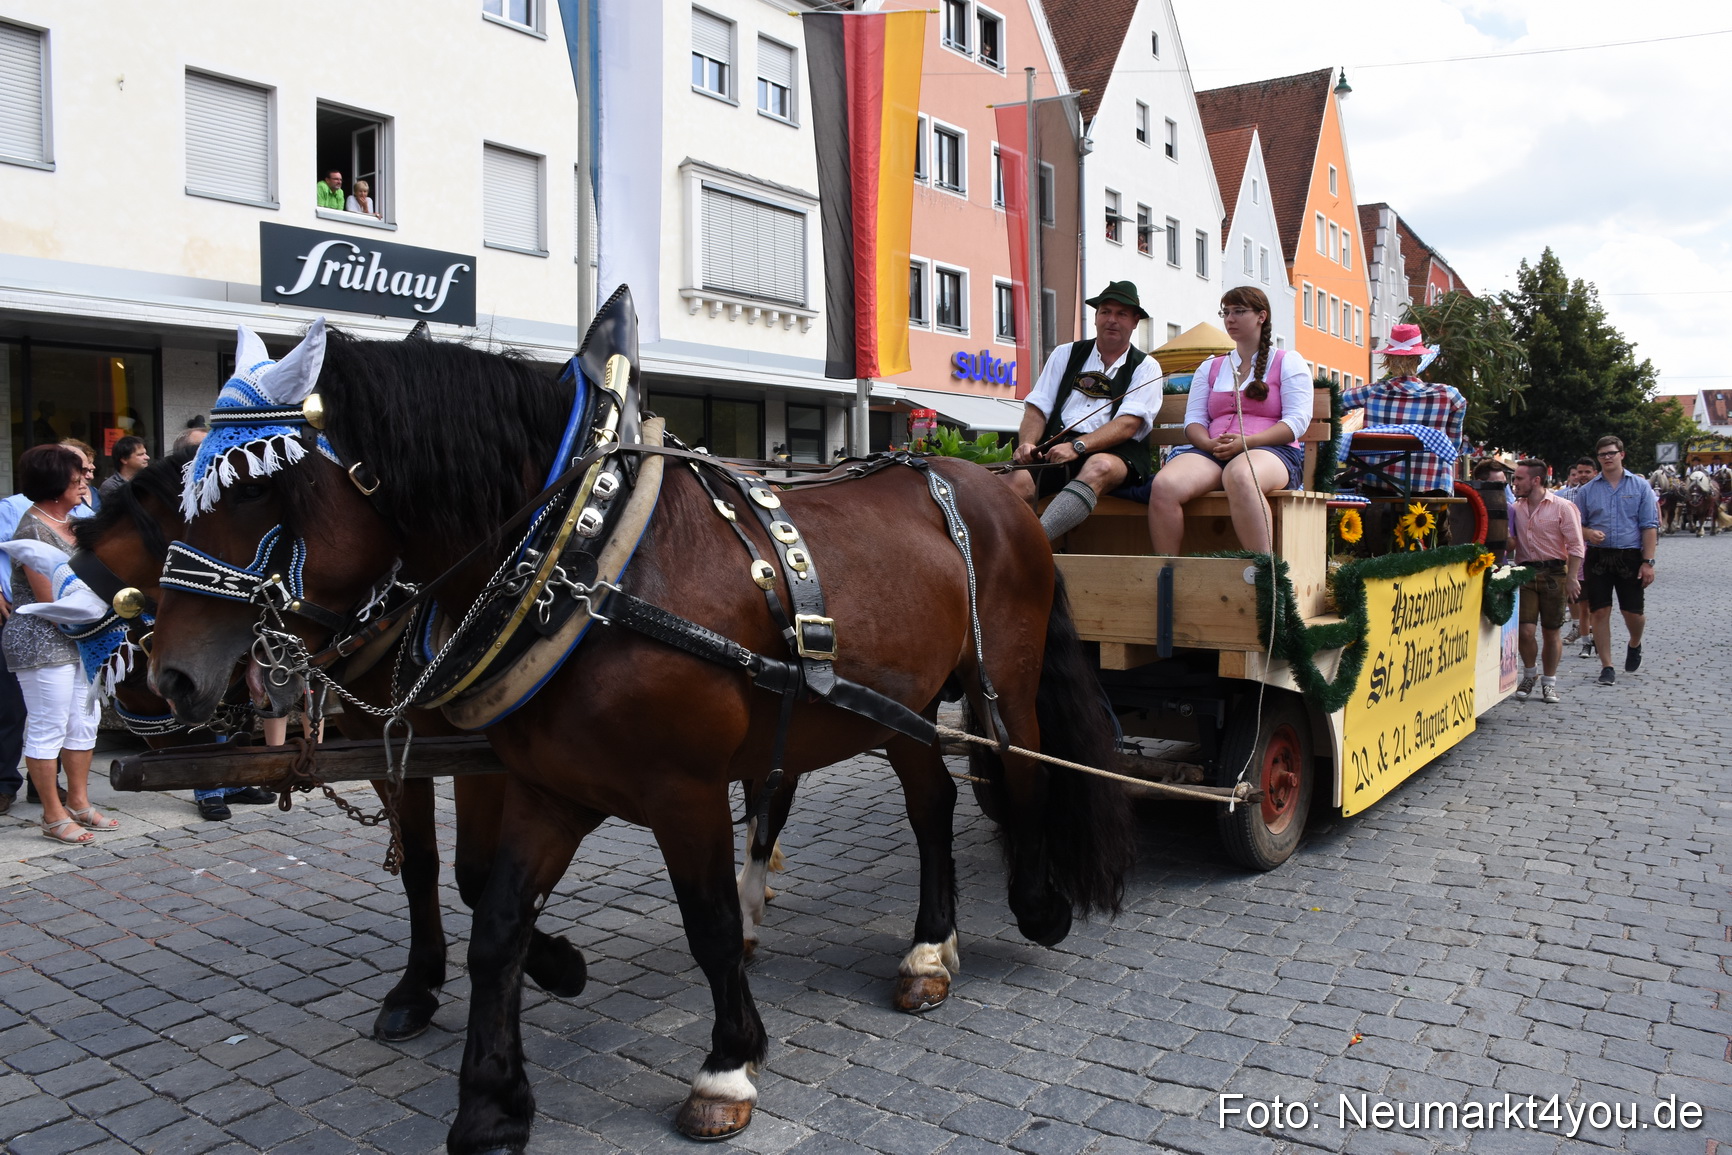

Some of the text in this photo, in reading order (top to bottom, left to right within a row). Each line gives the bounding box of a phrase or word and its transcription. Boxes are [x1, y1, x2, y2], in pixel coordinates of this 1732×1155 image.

[275, 239, 470, 314] frühauf
[1366, 623, 1469, 709] St. Pius Kirwa
[1351, 746, 1374, 795] 20.
[1377, 731, 1388, 775] &
[1393, 723, 1412, 766] 21.
[1413, 700, 1449, 752] August
